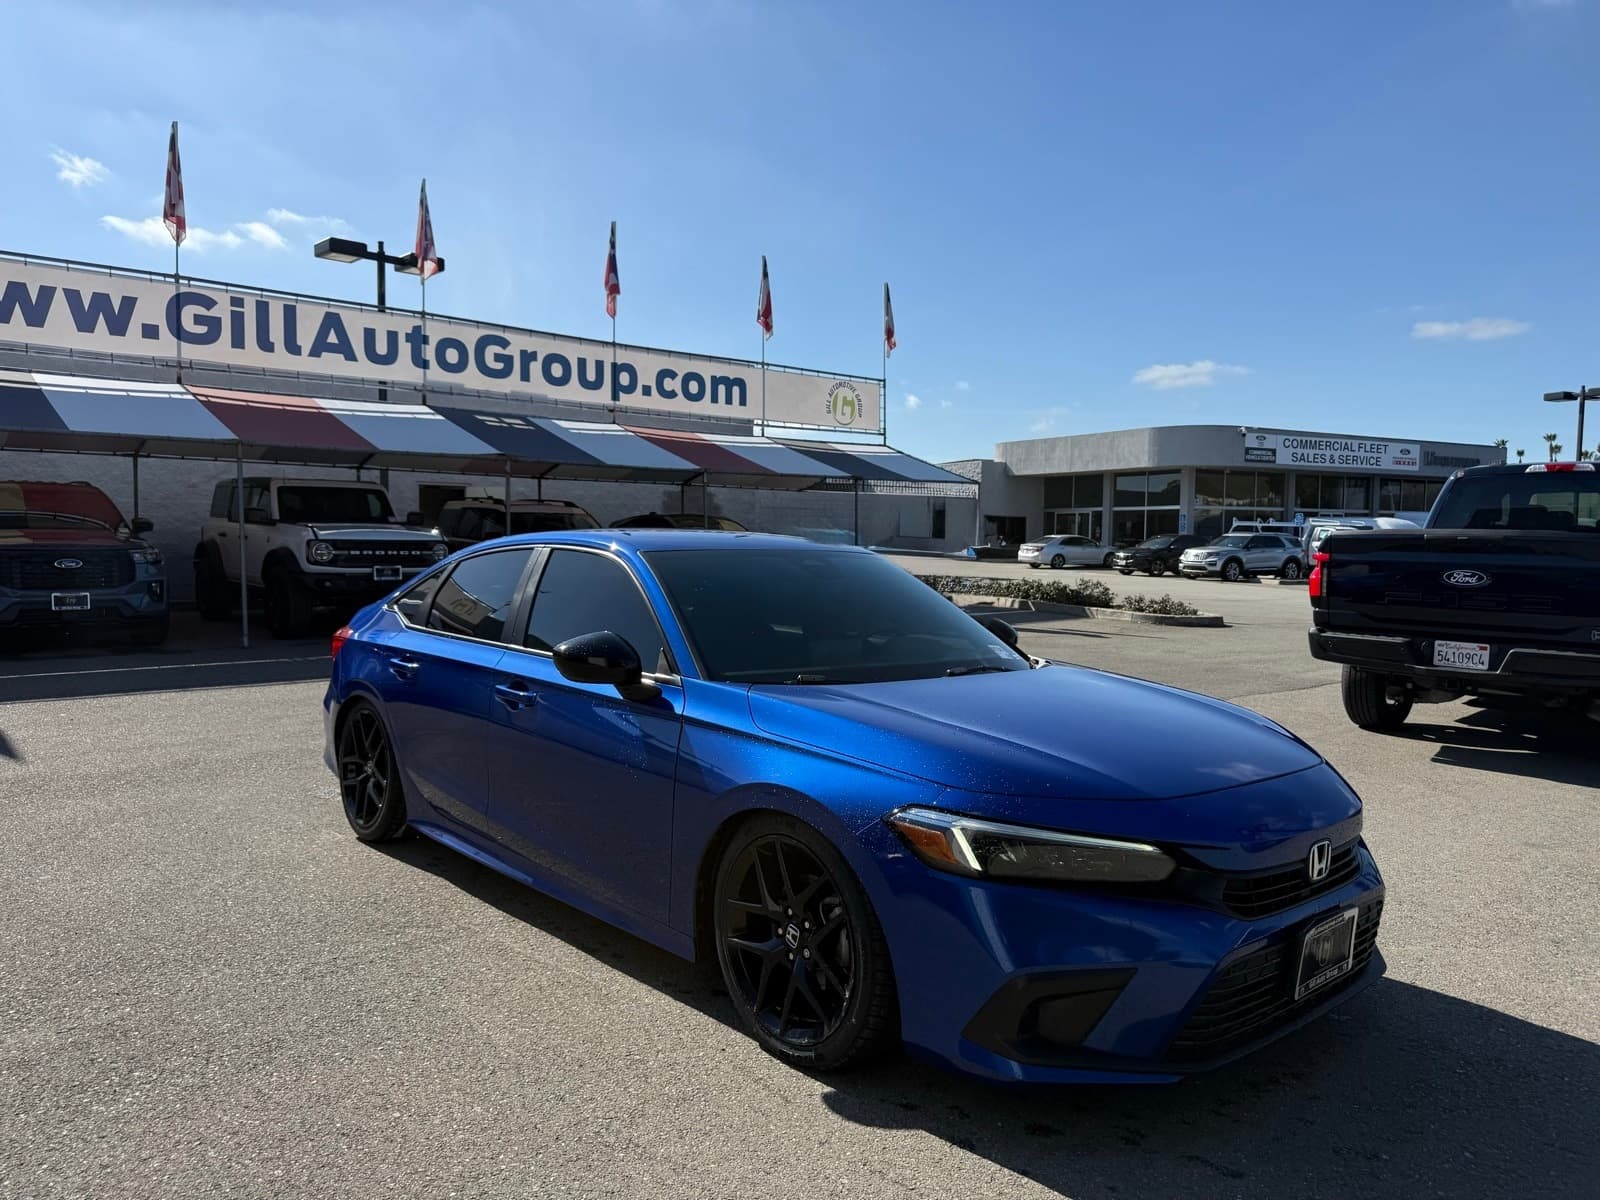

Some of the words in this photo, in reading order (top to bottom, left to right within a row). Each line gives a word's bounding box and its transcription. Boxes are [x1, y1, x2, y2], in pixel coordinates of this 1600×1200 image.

[1282, 437, 1356, 452] COMMERCIAL
[1357, 442, 1390, 455] FLEET
[1291, 451, 1327, 464] SALES
[1328, 453, 1336, 465] &
[1337, 454, 1382, 467] SERVICE
[1450, 571, 1479, 583] Ford
[1437, 649, 1485, 665] 54109C4
